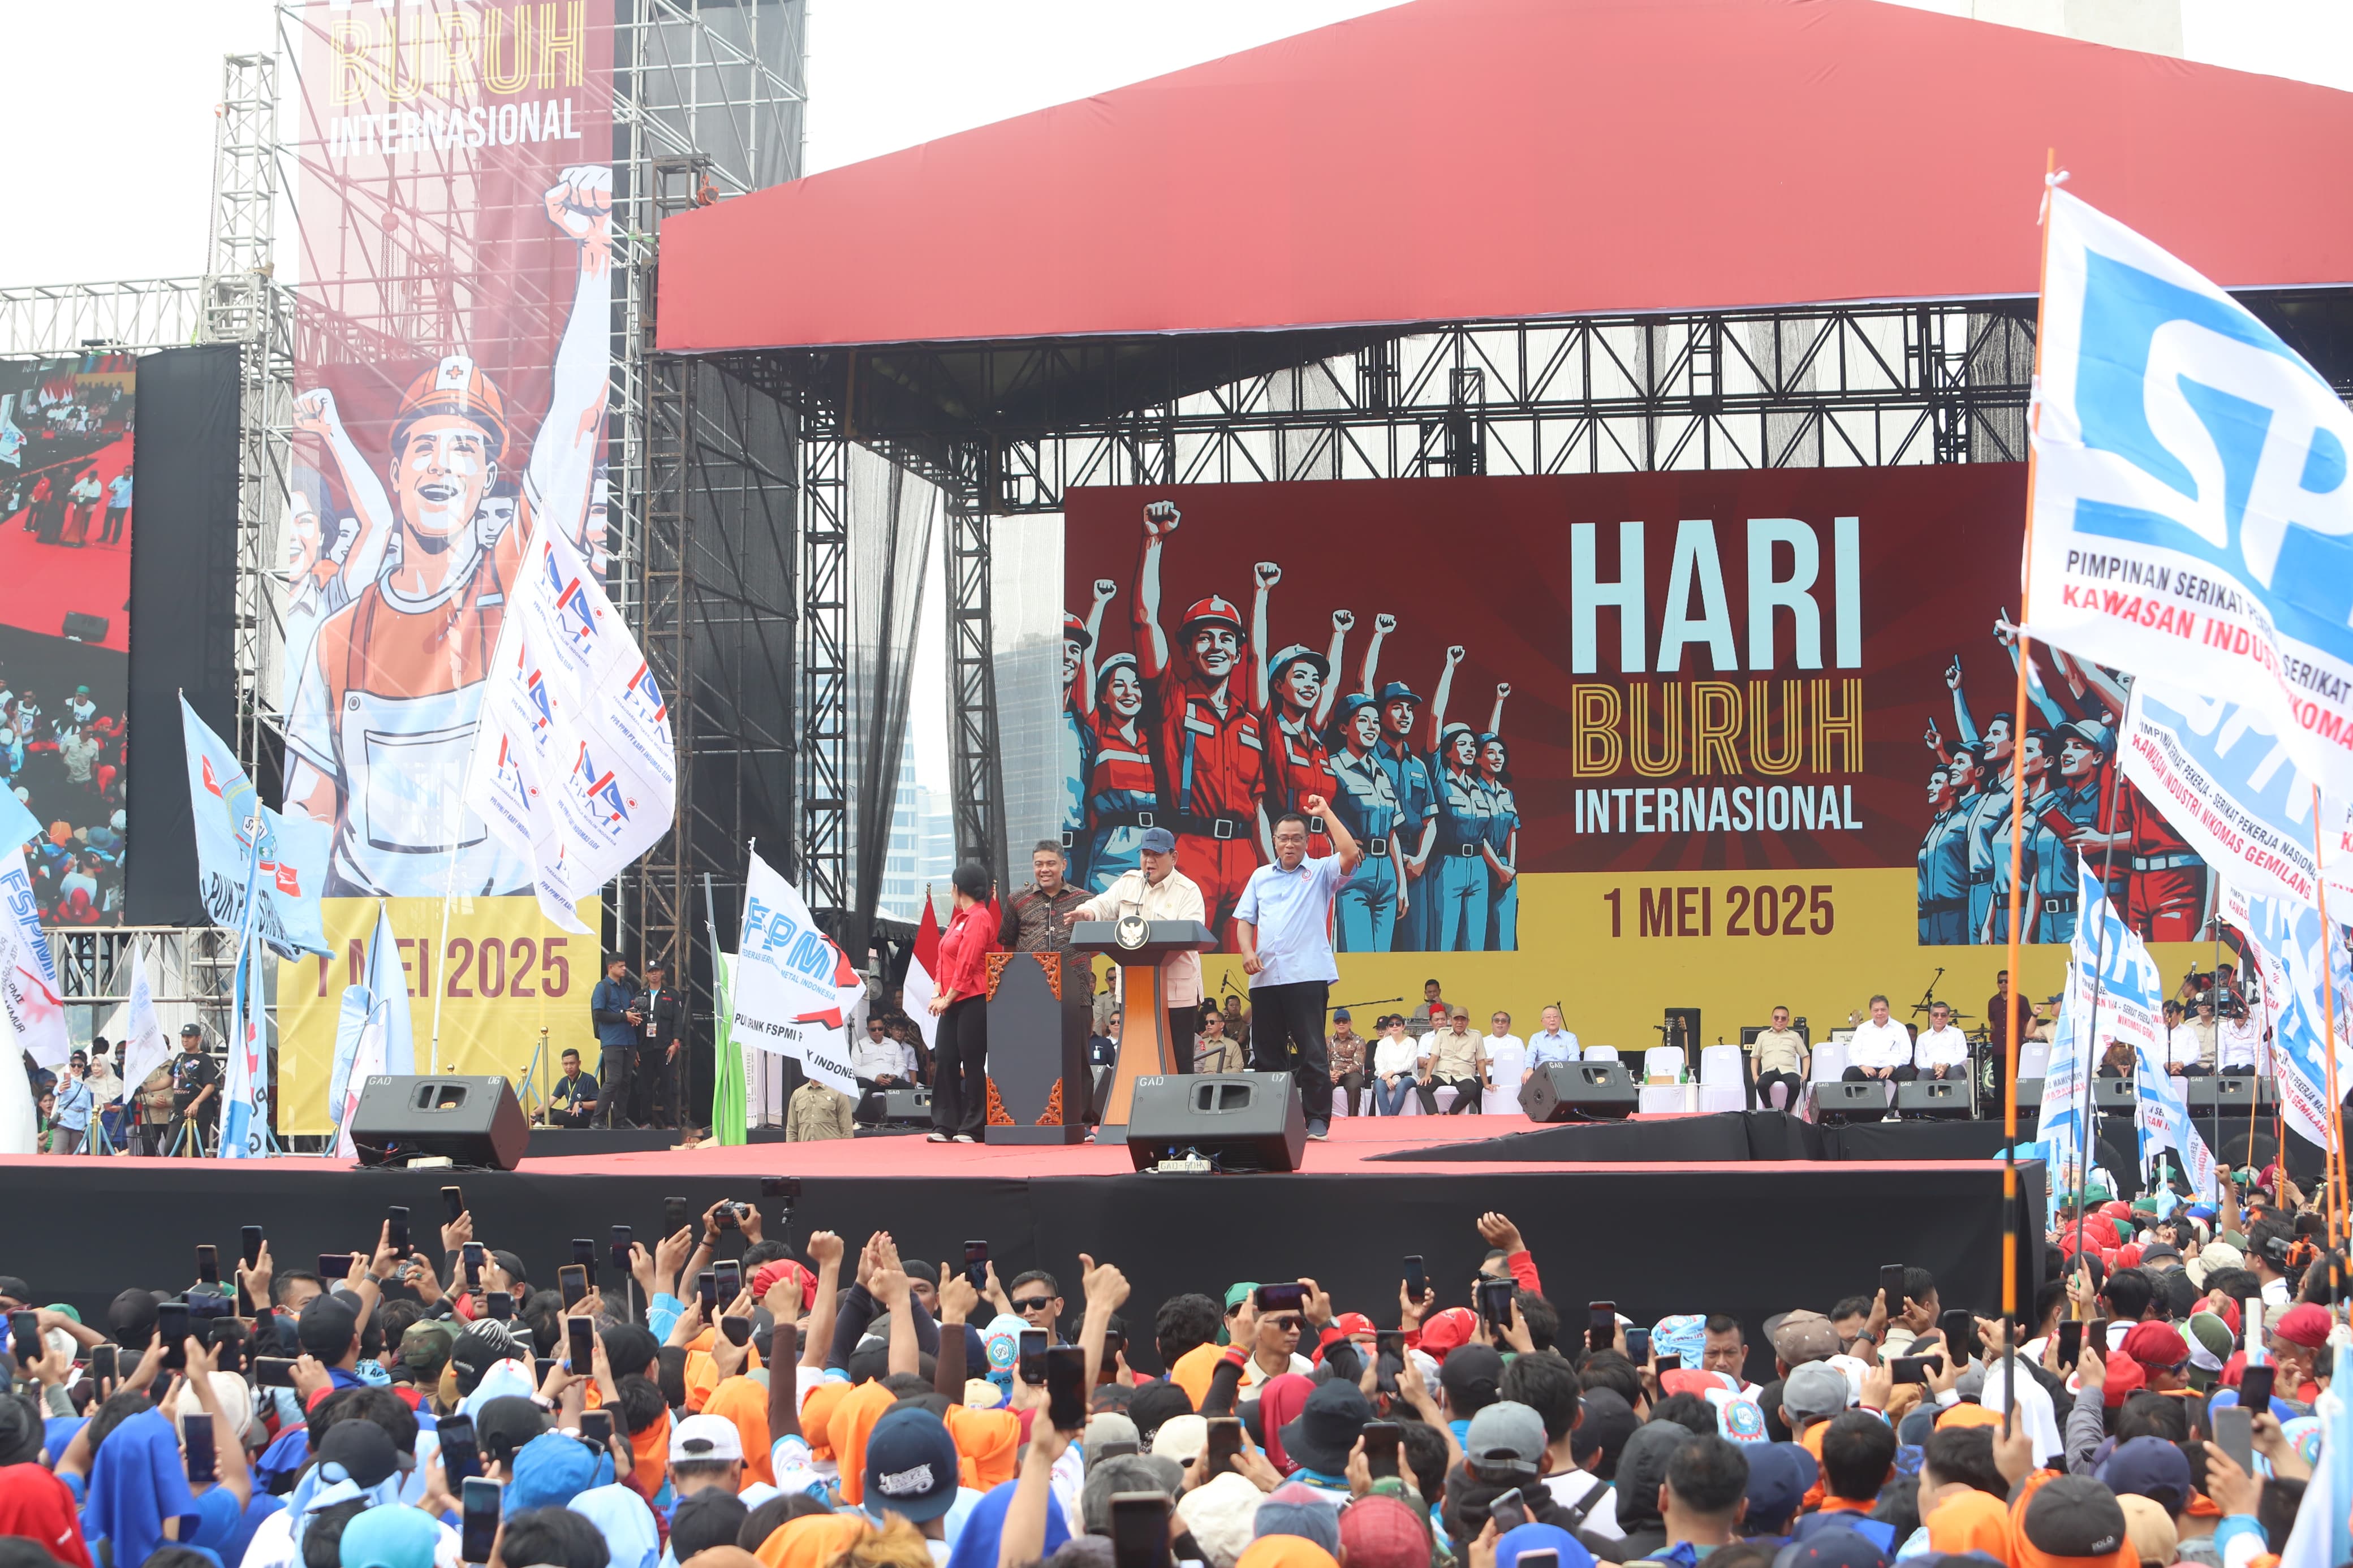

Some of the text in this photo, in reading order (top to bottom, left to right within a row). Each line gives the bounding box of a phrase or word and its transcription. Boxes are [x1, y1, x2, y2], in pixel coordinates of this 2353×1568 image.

[330, 0, 583, 106] BURUH
[330, 98, 581, 157] INTERNASIONAL
[1571, 516, 1862, 674] HARI
[2062, 584, 2197, 640] KAWASAN
[2065, 549, 2171, 591] PIMPINAN
[2174, 571, 2243, 615] SERIKAT
[2282, 654, 2352, 705] SERIKAT
[1572, 679, 1863, 777] BURUH
[1575, 785, 1863, 834] INTERNASIONAL
[2131, 733, 2312, 901] KAWASAN INDUSTRI NIKOMAS GEMILANG
[2183, 764, 2210, 797] PEKERJA
[2213, 793, 2239, 822] SERIKAT
[2236, 816, 2279, 850] PEKERJA
[2280, 841, 2317, 882] NASIONAL
[1604, 884, 1835, 938] 1 MEI 2025
[447, 938, 570, 997] 2025
[800, 977, 837, 1003] INDONESIA
[765, 1023, 797, 1040] FSPMI
[369, 1077, 500, 1086] GAD 06
[1139, 1072, 1287, 1087] GAD 07
[2292, 1075, 2315, 1102] PEKERJA
